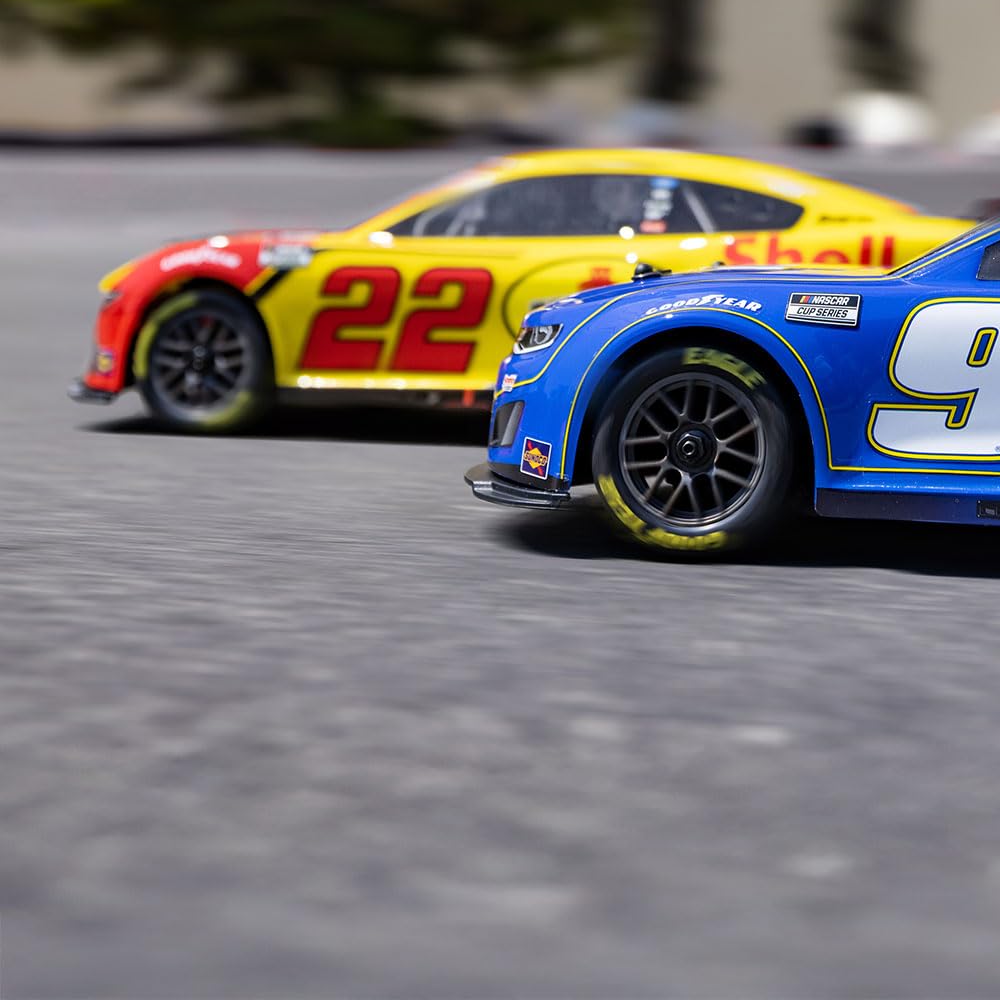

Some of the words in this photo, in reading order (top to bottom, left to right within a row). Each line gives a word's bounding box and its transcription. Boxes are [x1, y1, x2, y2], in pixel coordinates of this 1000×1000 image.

[644, 294, 763, 315] GOODYEAR
[811, 295, 850, 306] NASCAR
[299, 266, 493, 373] 22
[796, 306, 818, 316] CUP
[816, 307, 849, 319] SERIES
